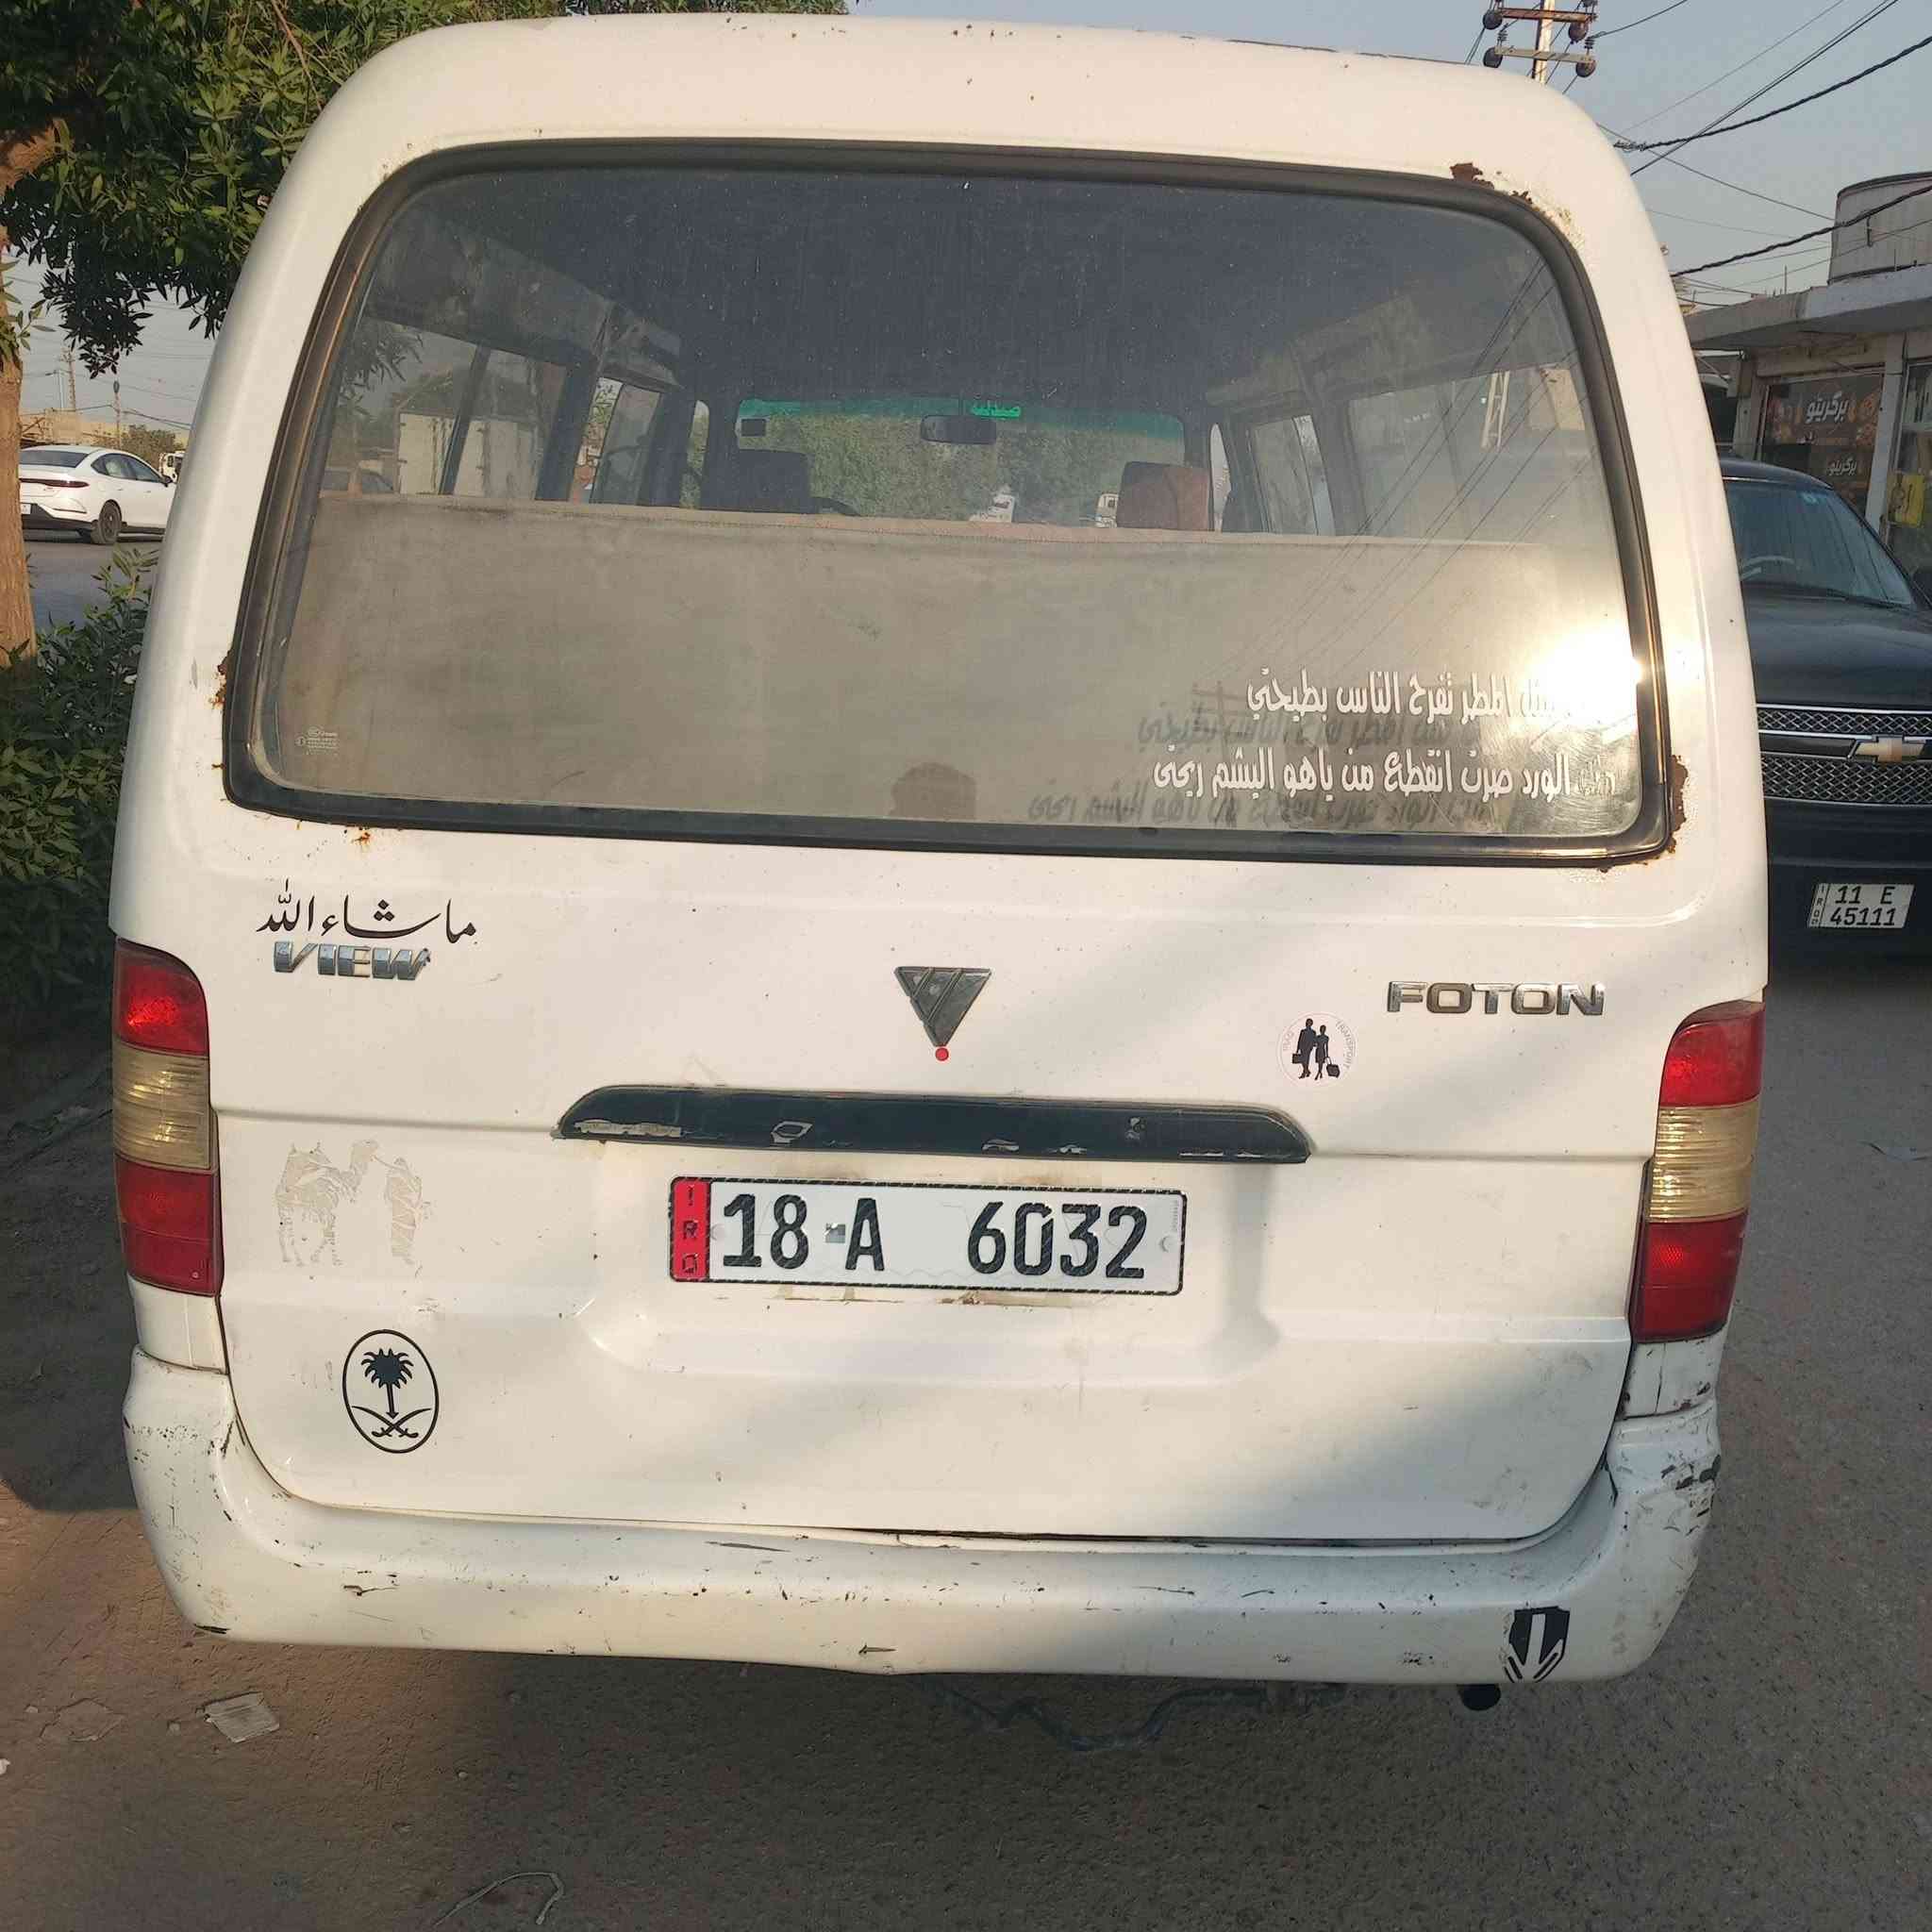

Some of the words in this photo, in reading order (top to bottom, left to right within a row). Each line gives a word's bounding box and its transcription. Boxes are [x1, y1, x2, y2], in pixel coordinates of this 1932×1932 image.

[1336, 671, 1402, 715] الناس
[1408, 672, 1454, 724] تفرح
[1461, 672, 1511, 725] المطر
[1341, 747, 1374, 792] من
[1461, 749, 1514, 803] صرت
[1522, 752, 1572, 803] الورد
[256, 877, 315, 932] الله
[1830, 907, 1897, 926] 45111
[1835, 885, 1862, 905] 11
[1880, 886, 1896, 905] E
[274, 941, 431, 981] VIEW
[1387, 980, 1606, 1016] FOTON
[723, 1192, 809, 1270] 18
[844, 1197, 886, 1272] A
[966, 1200, 1148, 1280] 6032
